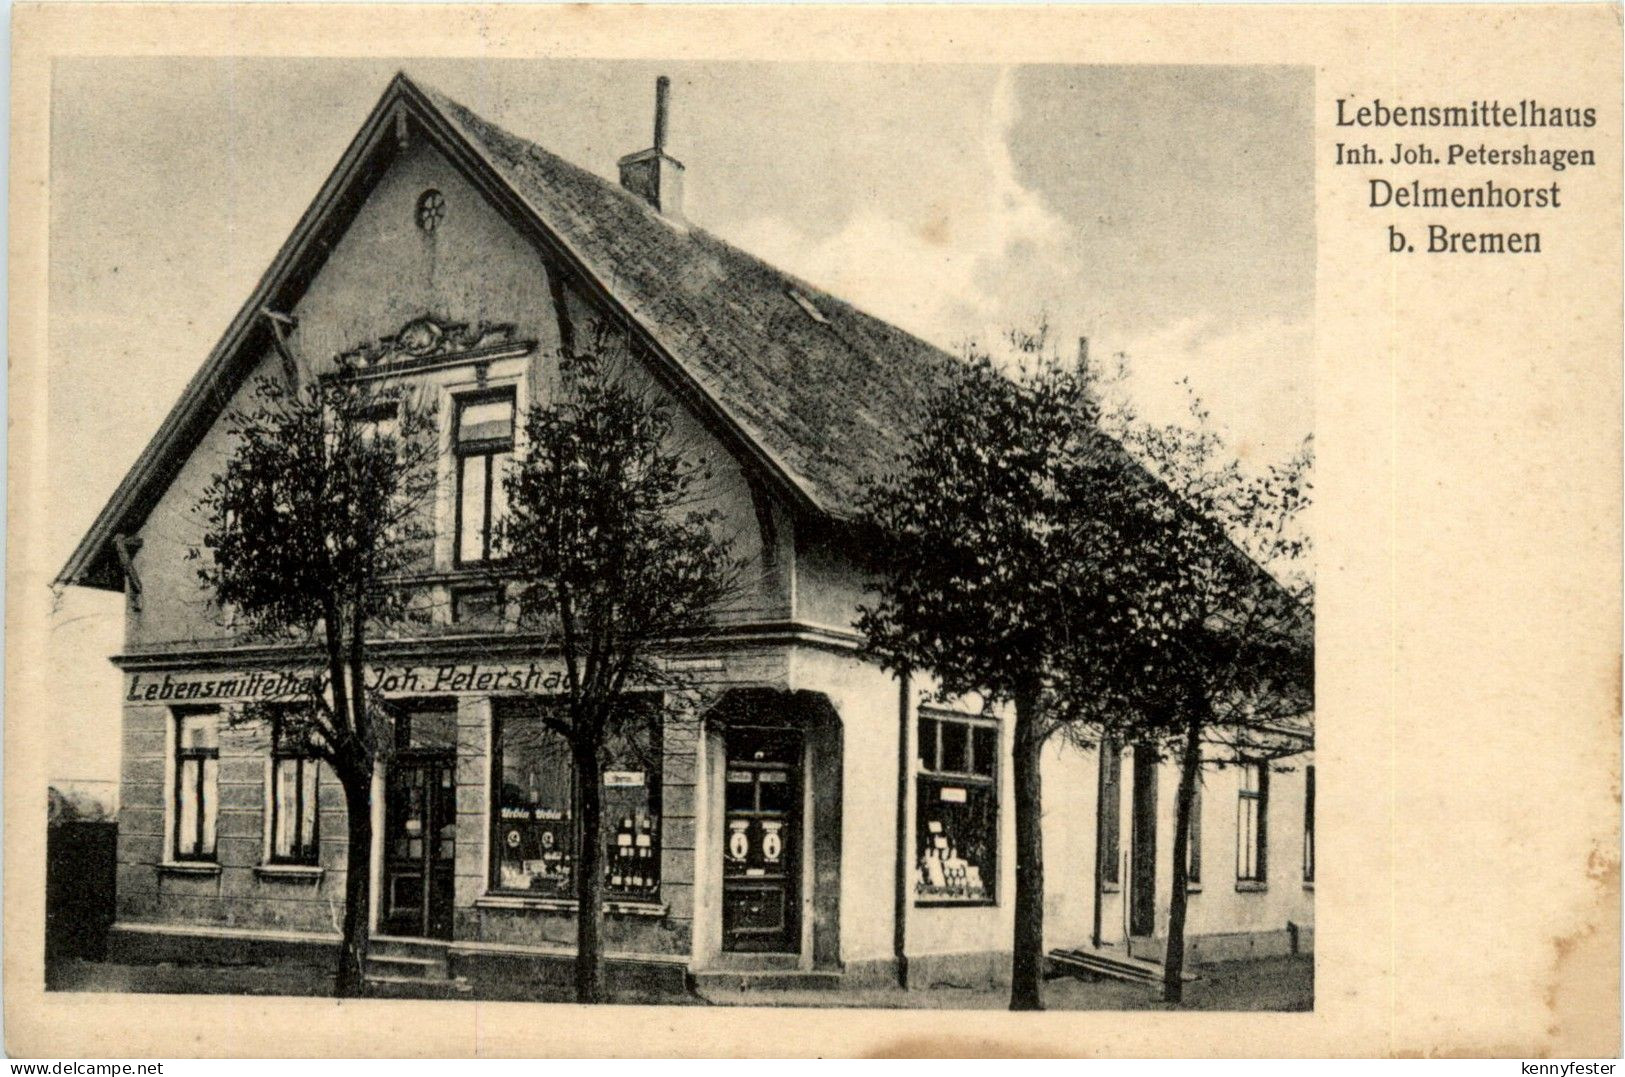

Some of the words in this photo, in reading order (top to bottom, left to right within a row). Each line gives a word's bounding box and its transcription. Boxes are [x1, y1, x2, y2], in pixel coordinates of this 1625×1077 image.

[1336, 99, 1597, 128] Lebensmittelhaus
[1336, 143, 1384, 165] Inh.
[1390, 143, 1440, 165] Joh.
[1447, 144, 1596, 171] Petershagen
[1369, 179, 1561, 208] Delmenhorst
[1388, 225, 1415, 253] b.
[1427, 224, 1541, 253] Bremen
[364, 666, 425, 691] Joh.
